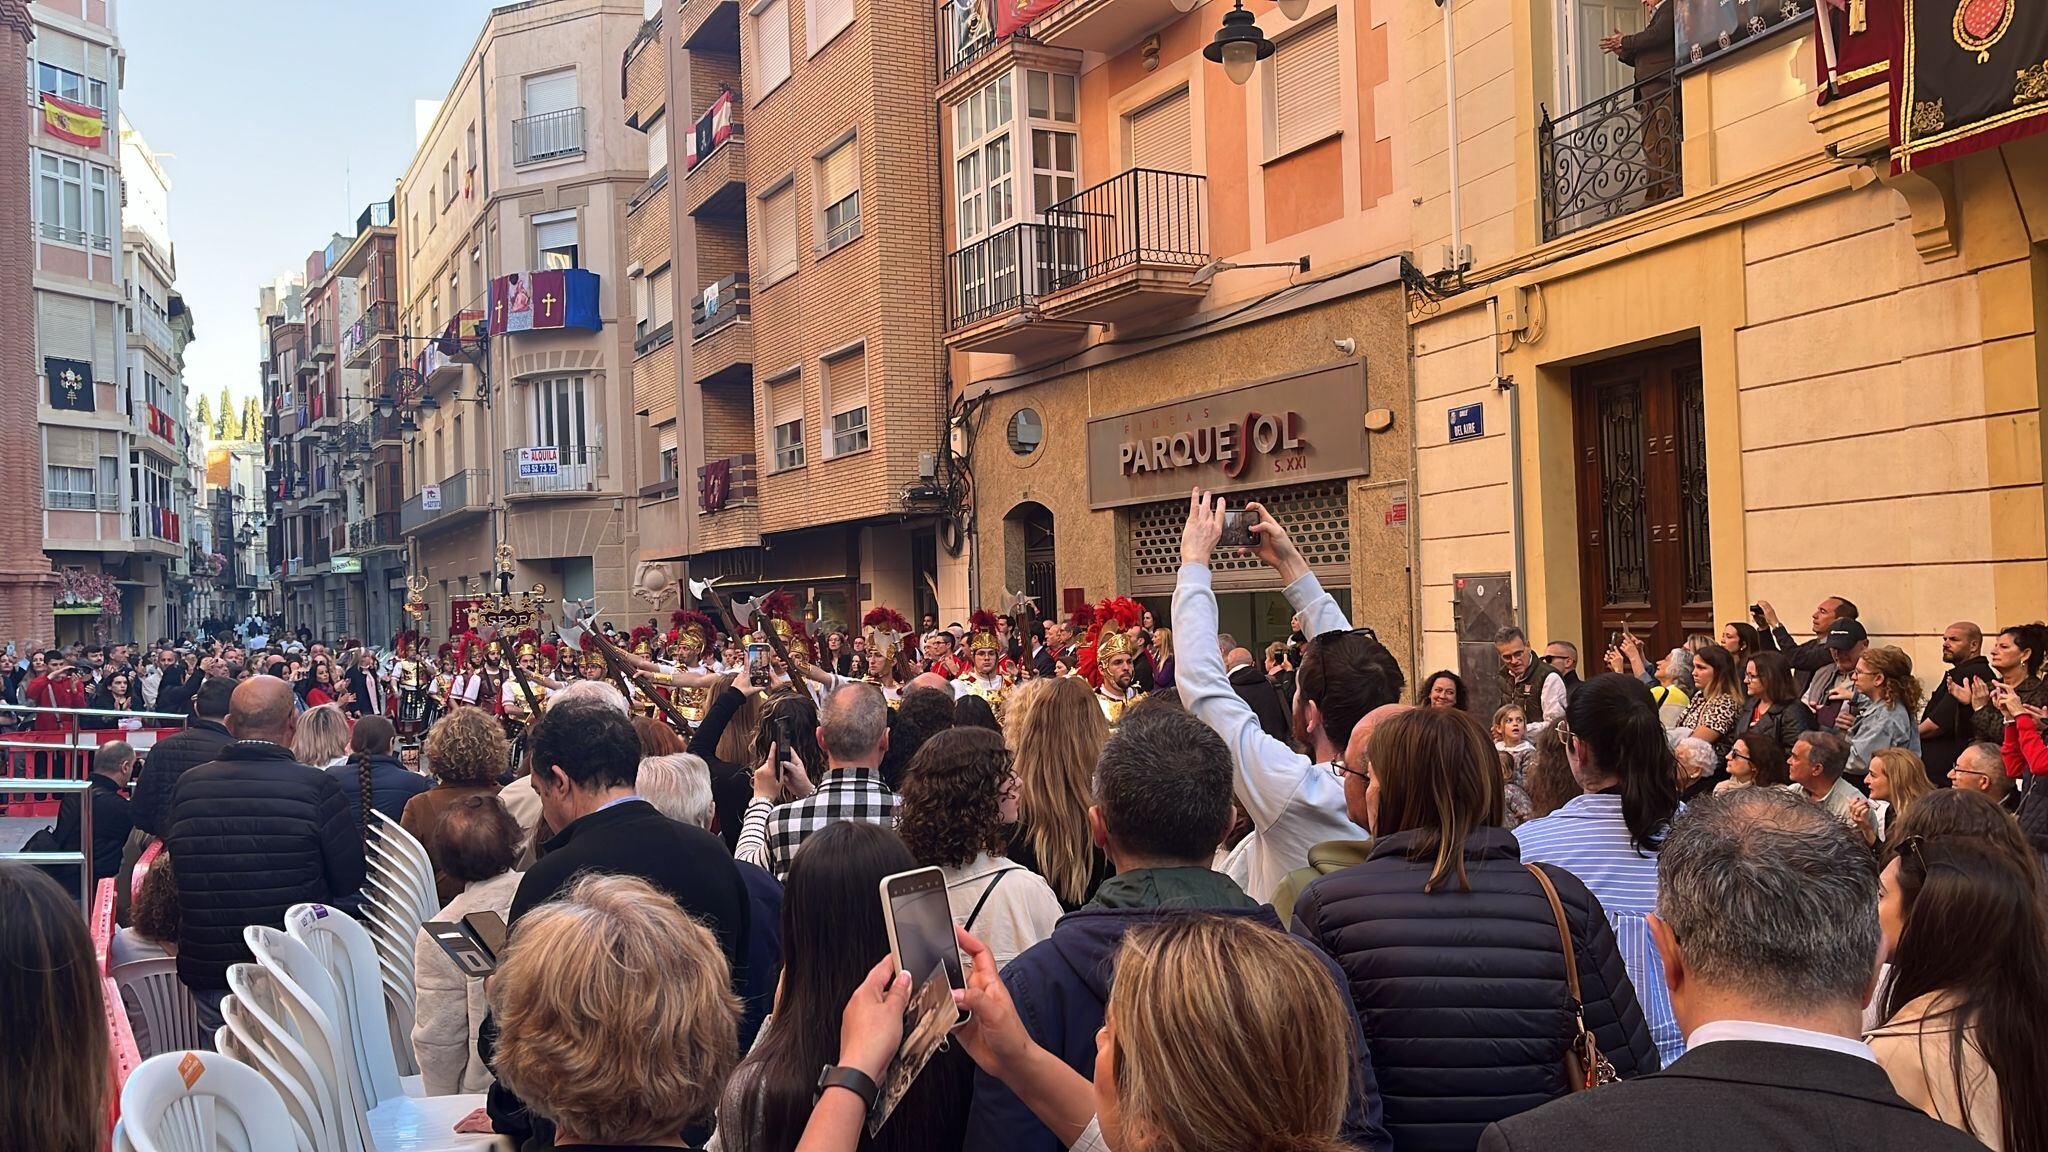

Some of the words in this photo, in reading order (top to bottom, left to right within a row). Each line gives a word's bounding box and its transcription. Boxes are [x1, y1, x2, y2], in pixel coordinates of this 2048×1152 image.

[531, 450, 557, 461] ALQUILA
[539, 464, 547, 472] 73
[548, 463, 556, 472] 73
[1287, 455, 1307, 471] XXI
